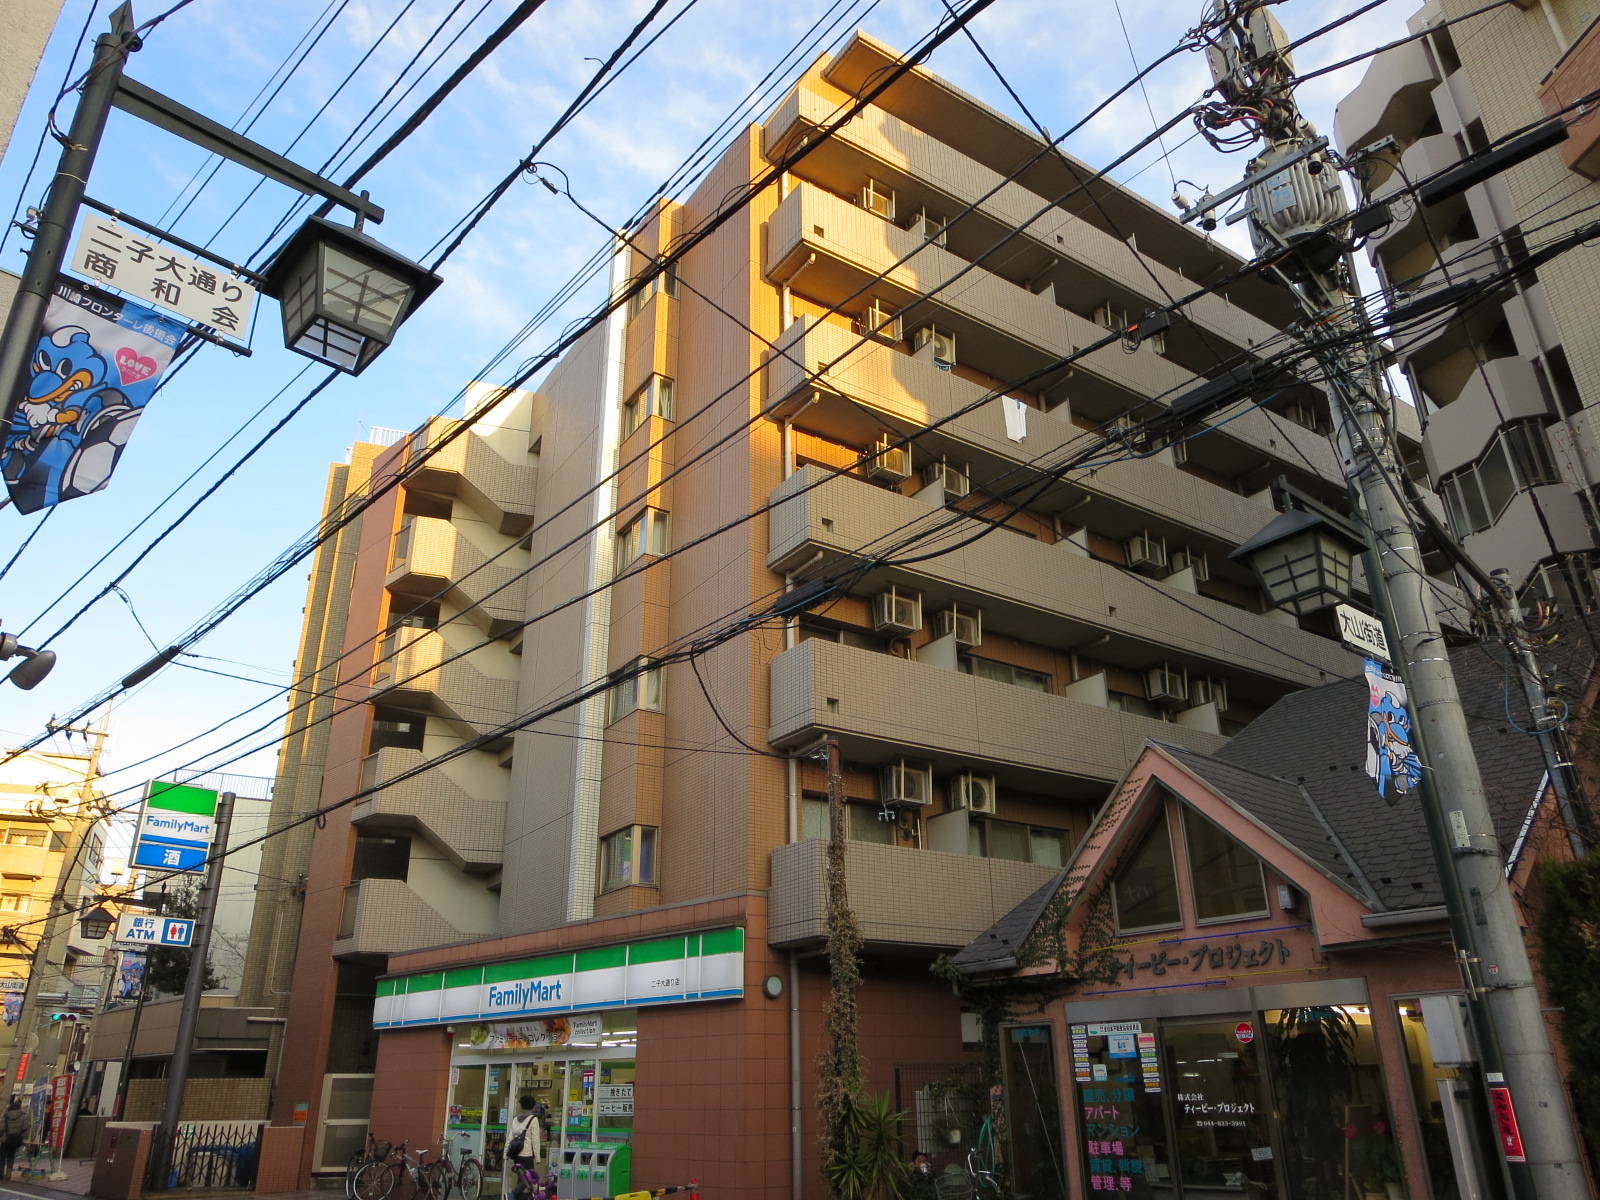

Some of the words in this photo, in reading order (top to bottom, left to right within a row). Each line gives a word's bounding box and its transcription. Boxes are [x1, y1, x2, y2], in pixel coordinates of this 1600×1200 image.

[89, 223, 244, 304] 二子大通り
[57, 285, 177, 346] 川崎フロンターレ後援会
[119, 355, 152, 377] LOVE
[1339, 608, 1388, 651] 大山街道
[146, 814, 210, 835] FamilyMart
[163, 848, 181, 867] 酒
[132, 917, 156, 929] 銀行
[126, 929, 156, 941] ATM
[651, 977, 680, 988] 二子大通り店
[488, 979, 562, 1011] FamilyMart
[573, 1020, 598, 1029] FamilyMart
[575, 1027, 596, 1036] collection
[610, 1087, 632, 1097] 挽きたて
[1177, 1093, 1204, 1101] 株式会社
[600, 1103, 633, 1113] コーヒー販売
[1084, 1105, 1120, 1120] アパート
[1086, 1123, 1140, 1137] マンション
[1087, 1140, 1125, 1156] 駐車場
